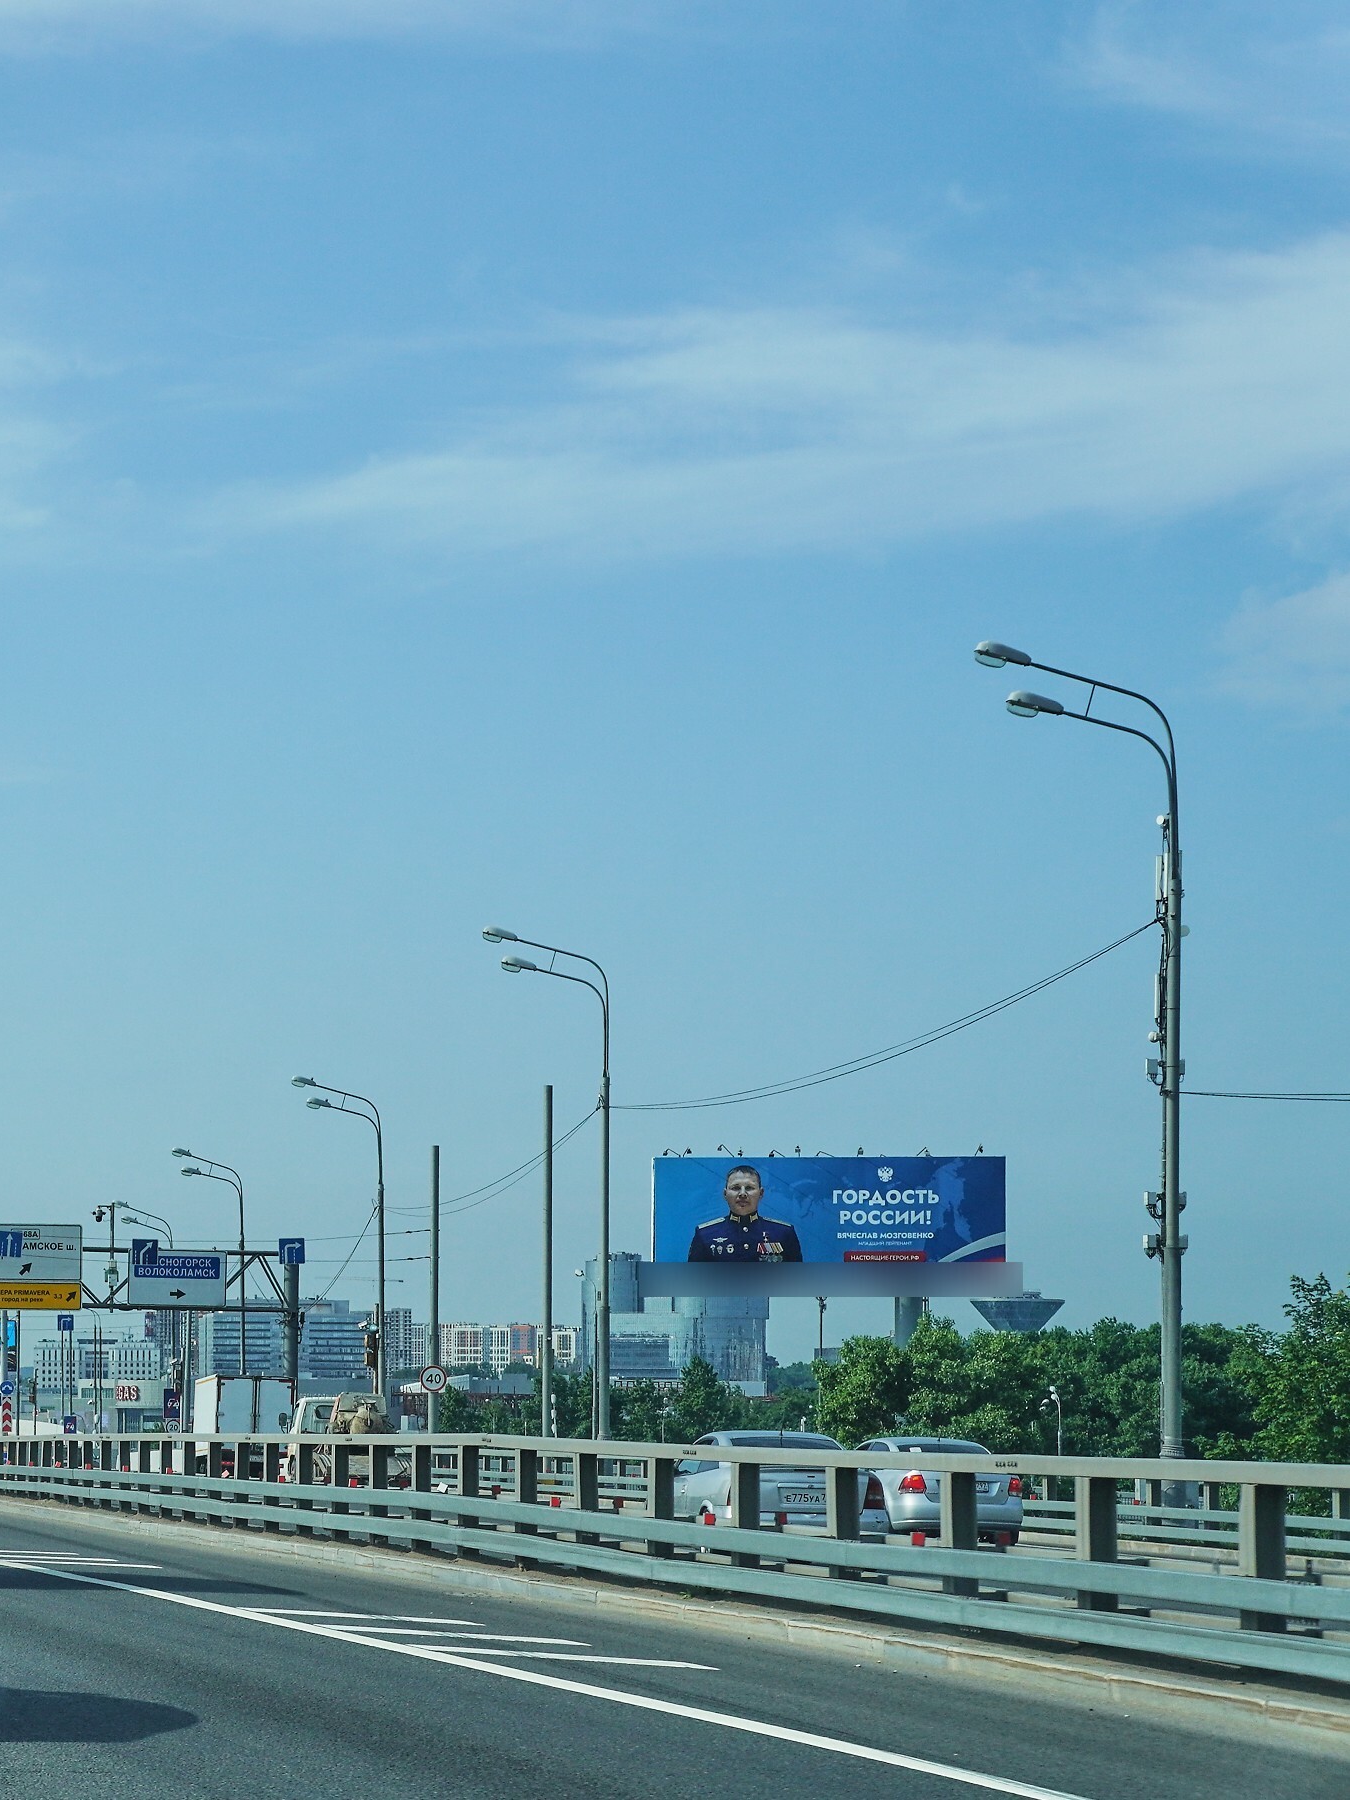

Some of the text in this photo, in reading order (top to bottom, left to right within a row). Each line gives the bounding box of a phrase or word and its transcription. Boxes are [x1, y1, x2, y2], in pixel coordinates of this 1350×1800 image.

[832, 1189, 940, 1206] ГОРДОСТЬ
[839, 1210, 932, 1225] РОССИИ!
[157, 1257, 212, 1267] СНОГОРСК
[138, 1267, 216, 1278] ВОЛОКОЛАМСК
[425, 1373, 442, 1384] 40
[786, 1493, 821, 1503] Е775УА
